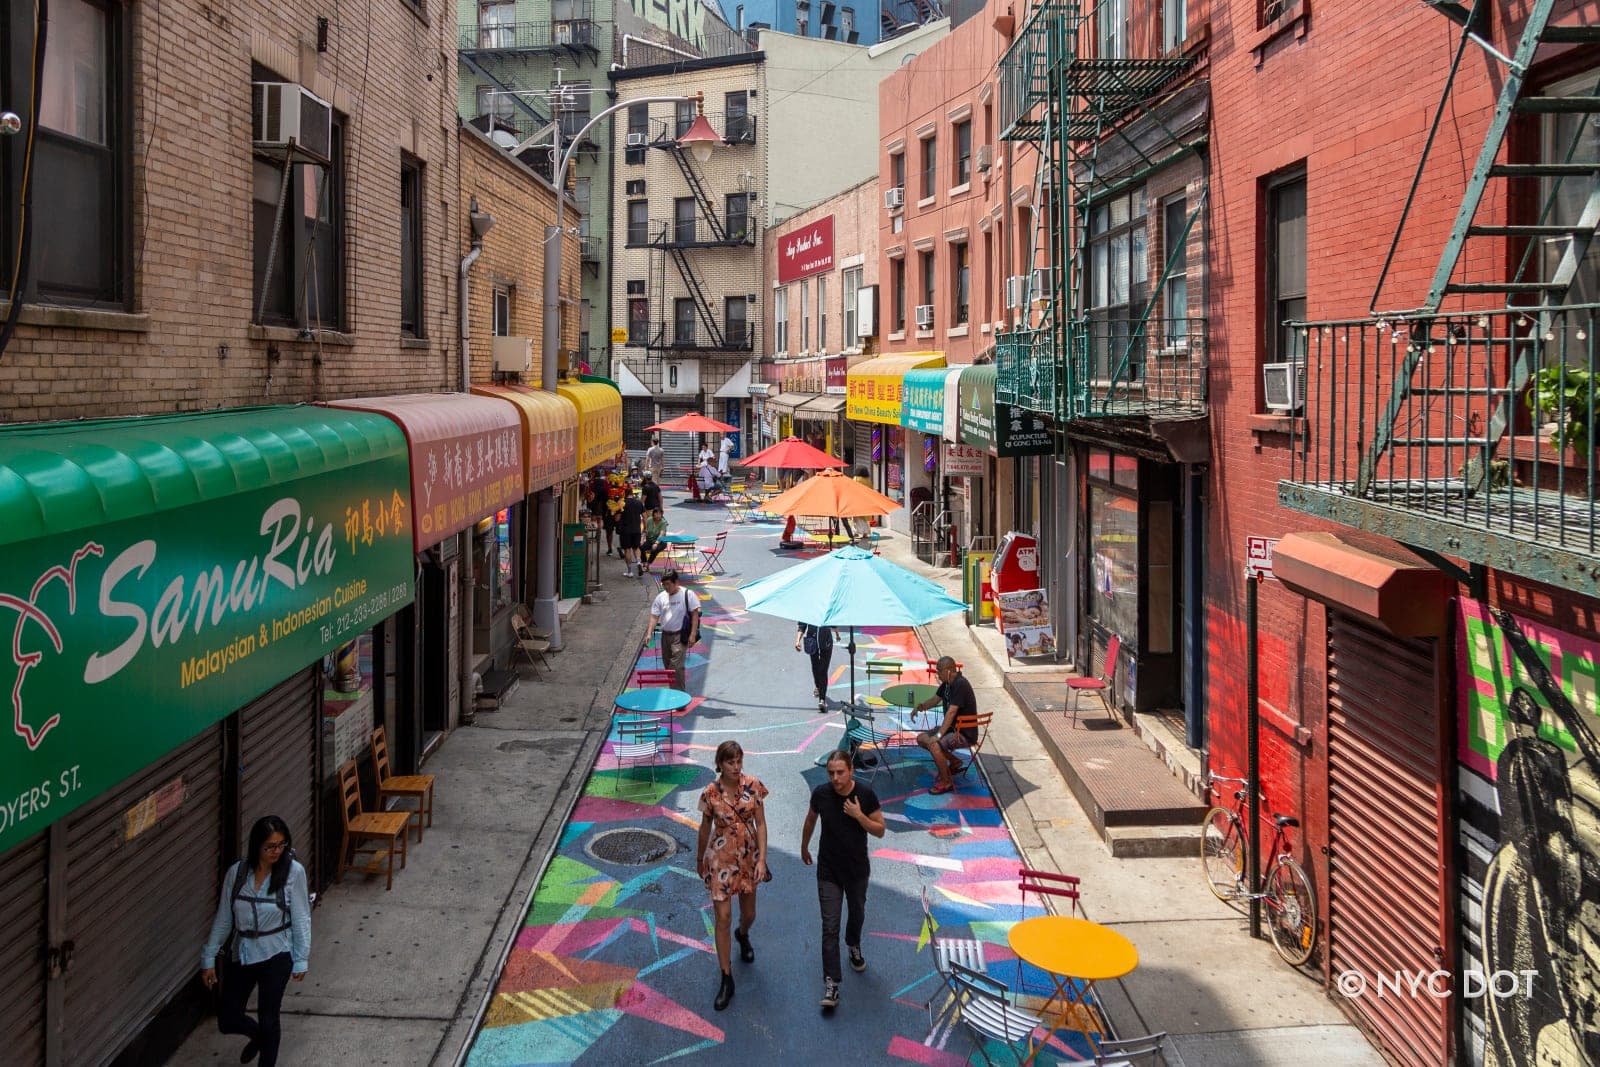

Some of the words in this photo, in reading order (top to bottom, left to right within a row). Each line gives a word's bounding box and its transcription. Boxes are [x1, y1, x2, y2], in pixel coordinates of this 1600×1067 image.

[864, 404, 876, 416] China
[1009, 432, 1048, 441] ACUPUNCTURE
[1013, 439, 1031, 447] GONG
[434, 503, 448, 532] NEW
[1017, 547, 1035, 556] ATM
[180, 634, 257, 689] Malaysian
[258, 624, 269, 648] &
[271, 596, 332, 641] Indonesian
[334, 578, 369, 608] Cuisine
[319, 623, 334, 645] Tel:
[59, 764, 82, 798] ST.
